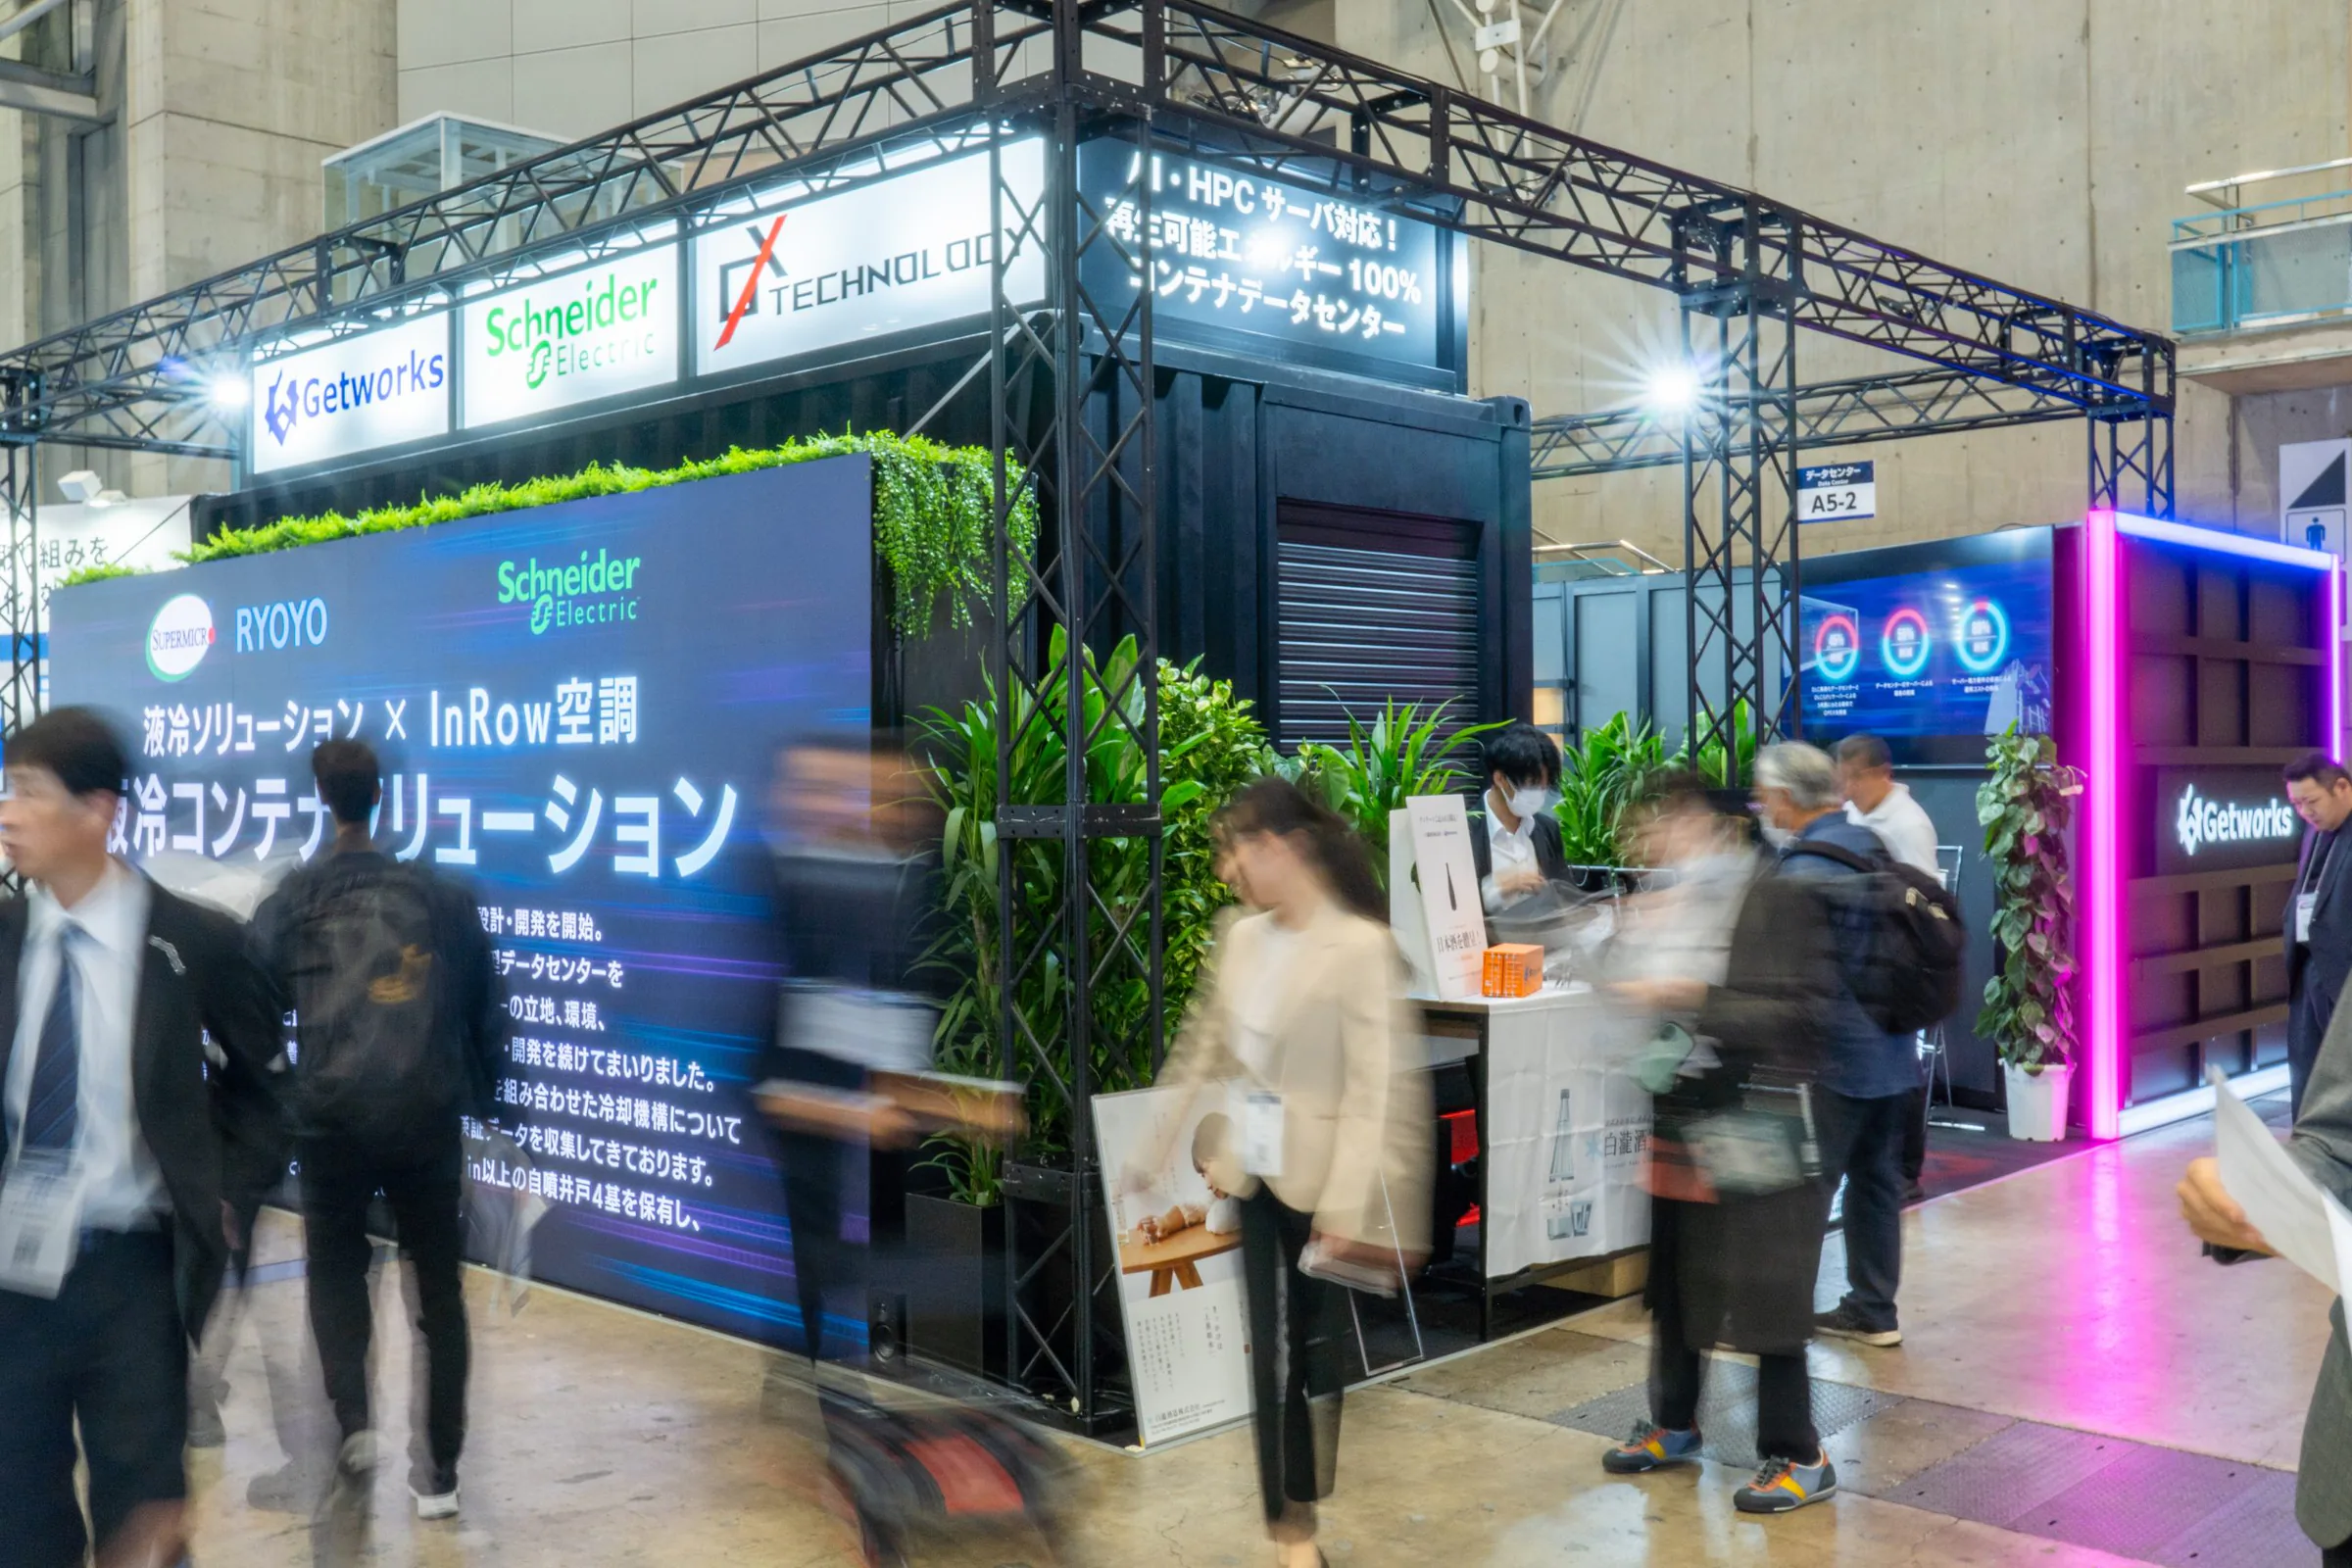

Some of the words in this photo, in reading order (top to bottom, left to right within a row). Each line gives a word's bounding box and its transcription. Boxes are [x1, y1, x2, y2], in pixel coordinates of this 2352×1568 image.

[1261, 184, 1396, 252] サーバ対応！
[1104, 196, 1343, 281] 再生可能エギー
[1348, 258, 1423, 305] 100%
[486, 273, 658, 357] Schneider
[557, 330, 656, 376] Electric
[304, 349, 445, 418] Getworks
[1806, 466, 1861, 481] データセンター
[1811, 491, 1857, 514] A5-2
[498, 548, 641, 604] Schneider
[236, 596, 328, 654] RYOYO
[557, 596, 638, 627] Electric
[143, 699, 364, 758] 液冷ソリューション
[429, 675, 638, 747] InRow空調
[106, 772, 737, 878] 冷コンテナリューション
[2205, 797, 2293, 843] Getworks
